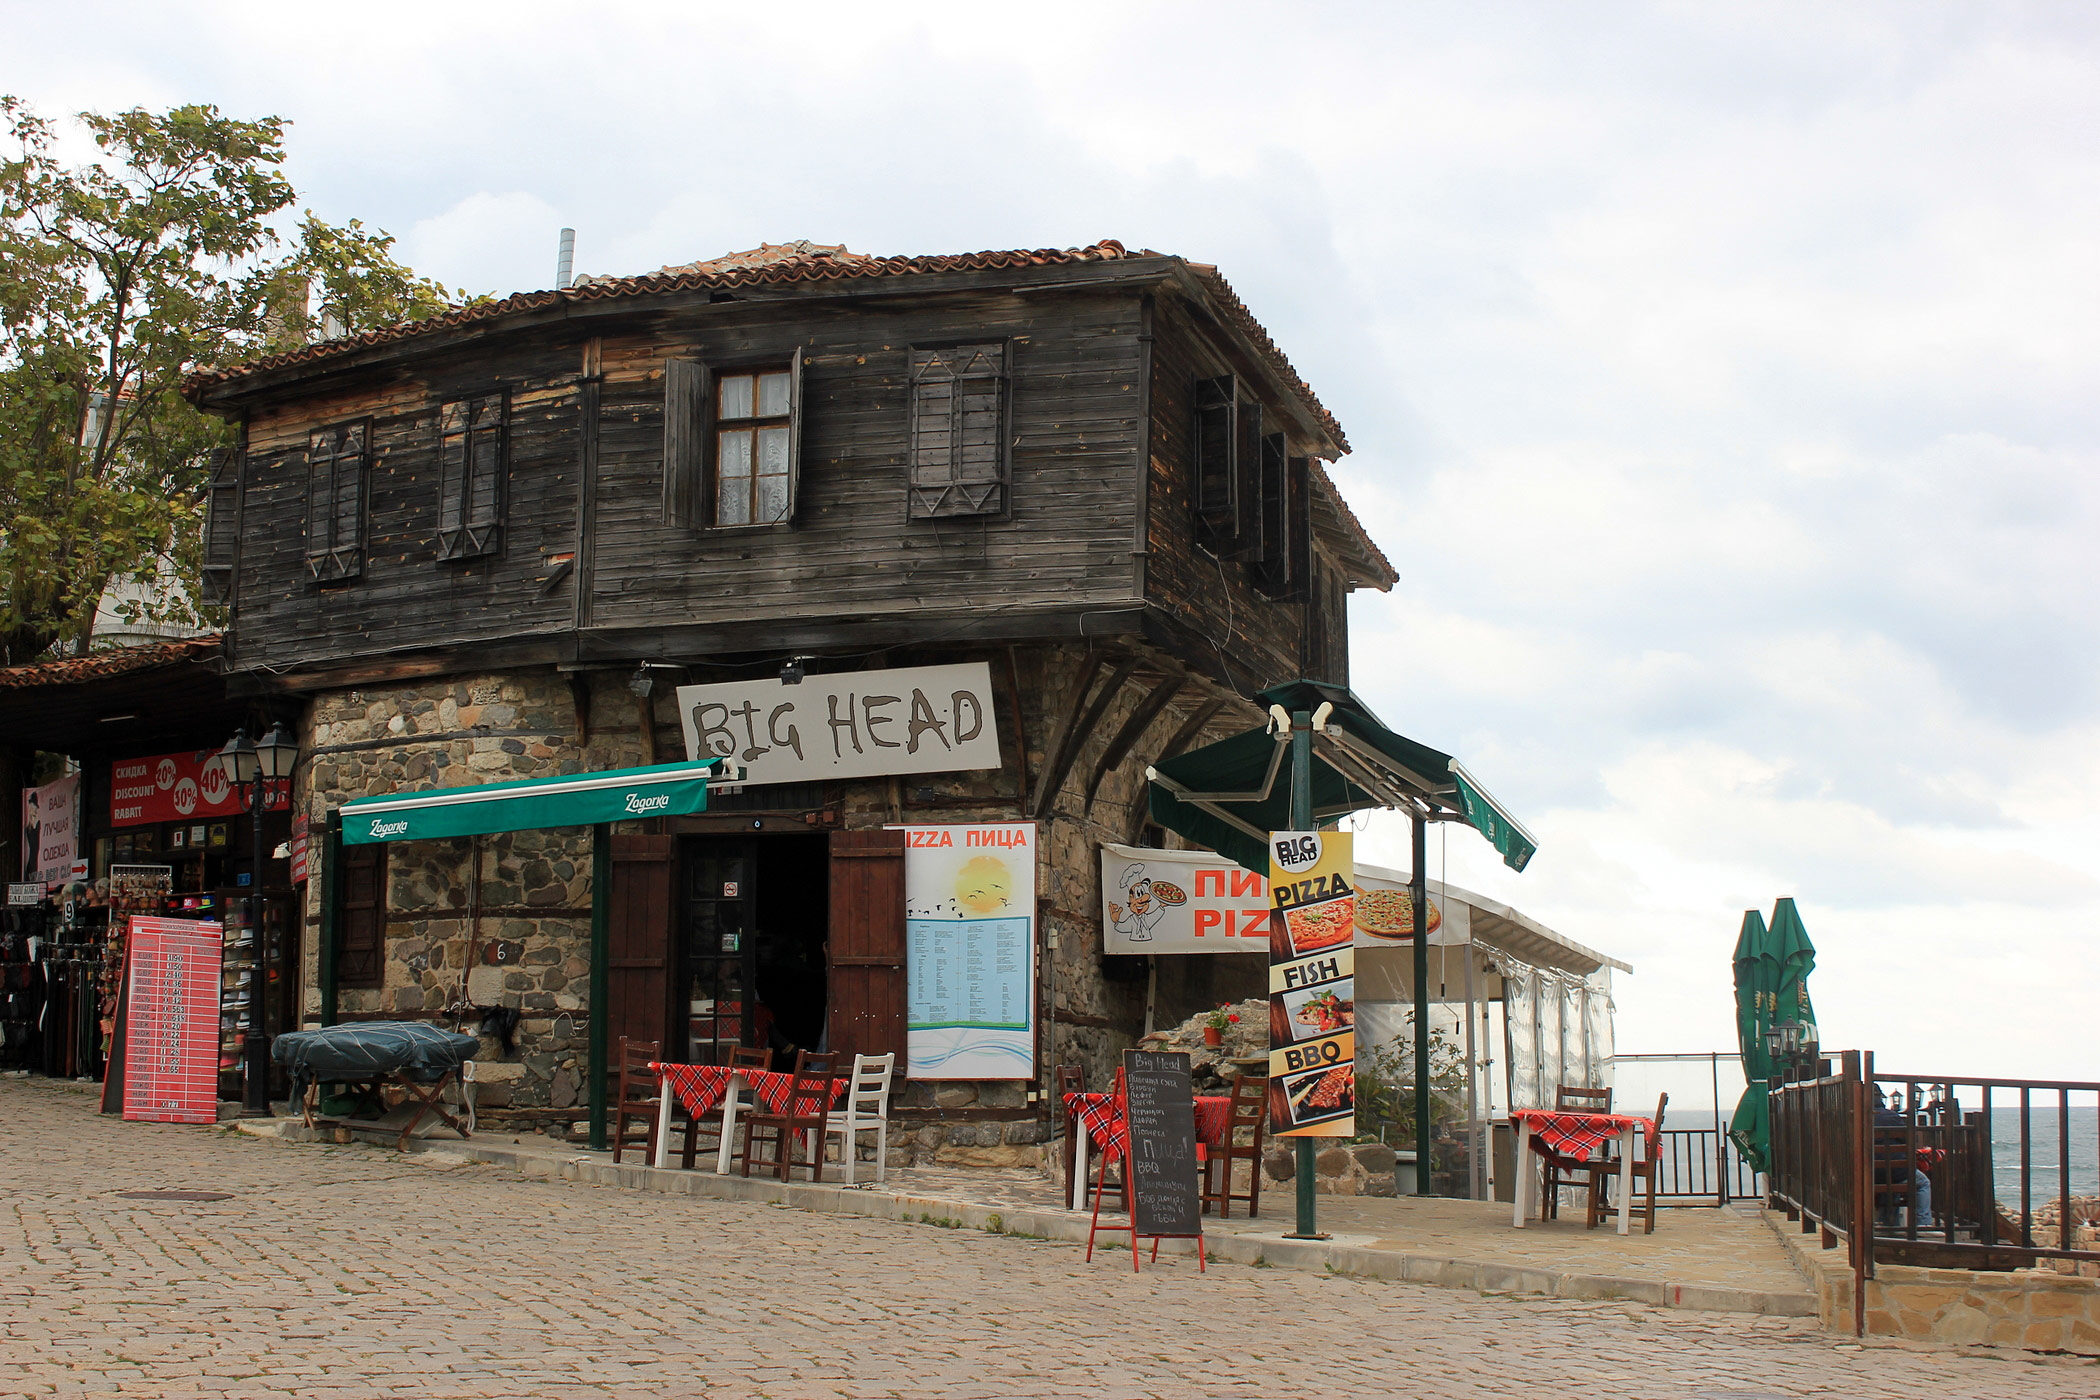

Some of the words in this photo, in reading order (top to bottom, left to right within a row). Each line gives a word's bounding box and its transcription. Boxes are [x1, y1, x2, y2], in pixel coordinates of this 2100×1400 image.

[693, 701, 803, 761] BIG
[827, 688, 982, 758] HEAD
[115, 765, 147, 779] СКИДКА
[156, 766, 177, 784] 20%
[201, 767, 230, 794] 40%
[115, 785, 155, 800] DISCOUNT
[174, 787, 197, 808] 30%
[48, 795, 67, 811] ВАША
[625, 793, 670, 814] Zagorka
[114, 806, 142, 820] RABATT
[43, 817, 69, 837] ЛУЧШАЯ
[369, 819, 408, 838] Zagorka
[966, 829, 1027, 850] ПИЦА
[1275, 836, 1317, 861] BIG
[43, 842, 70, 861] ОДЕЖДА
[1281, 852, 1317, 867] HEAD
[1195, 870, 1270, 898] ПИ
[1273, 873, 1350, 907] PIZZA
[66, 903, 73, 919] 9
[138, 952, 152, 960] EUR
[497, 943, 506, 960] 6
[1283, 957, 1340, 988] FISH
[1135, 1053, 1153, 1072] Big
[1157, 1056, 1180, 1071] Head
[1285, 1041, 1340, 1071] BBQ
[1137, 1160, 1161, 1175] BBQ
